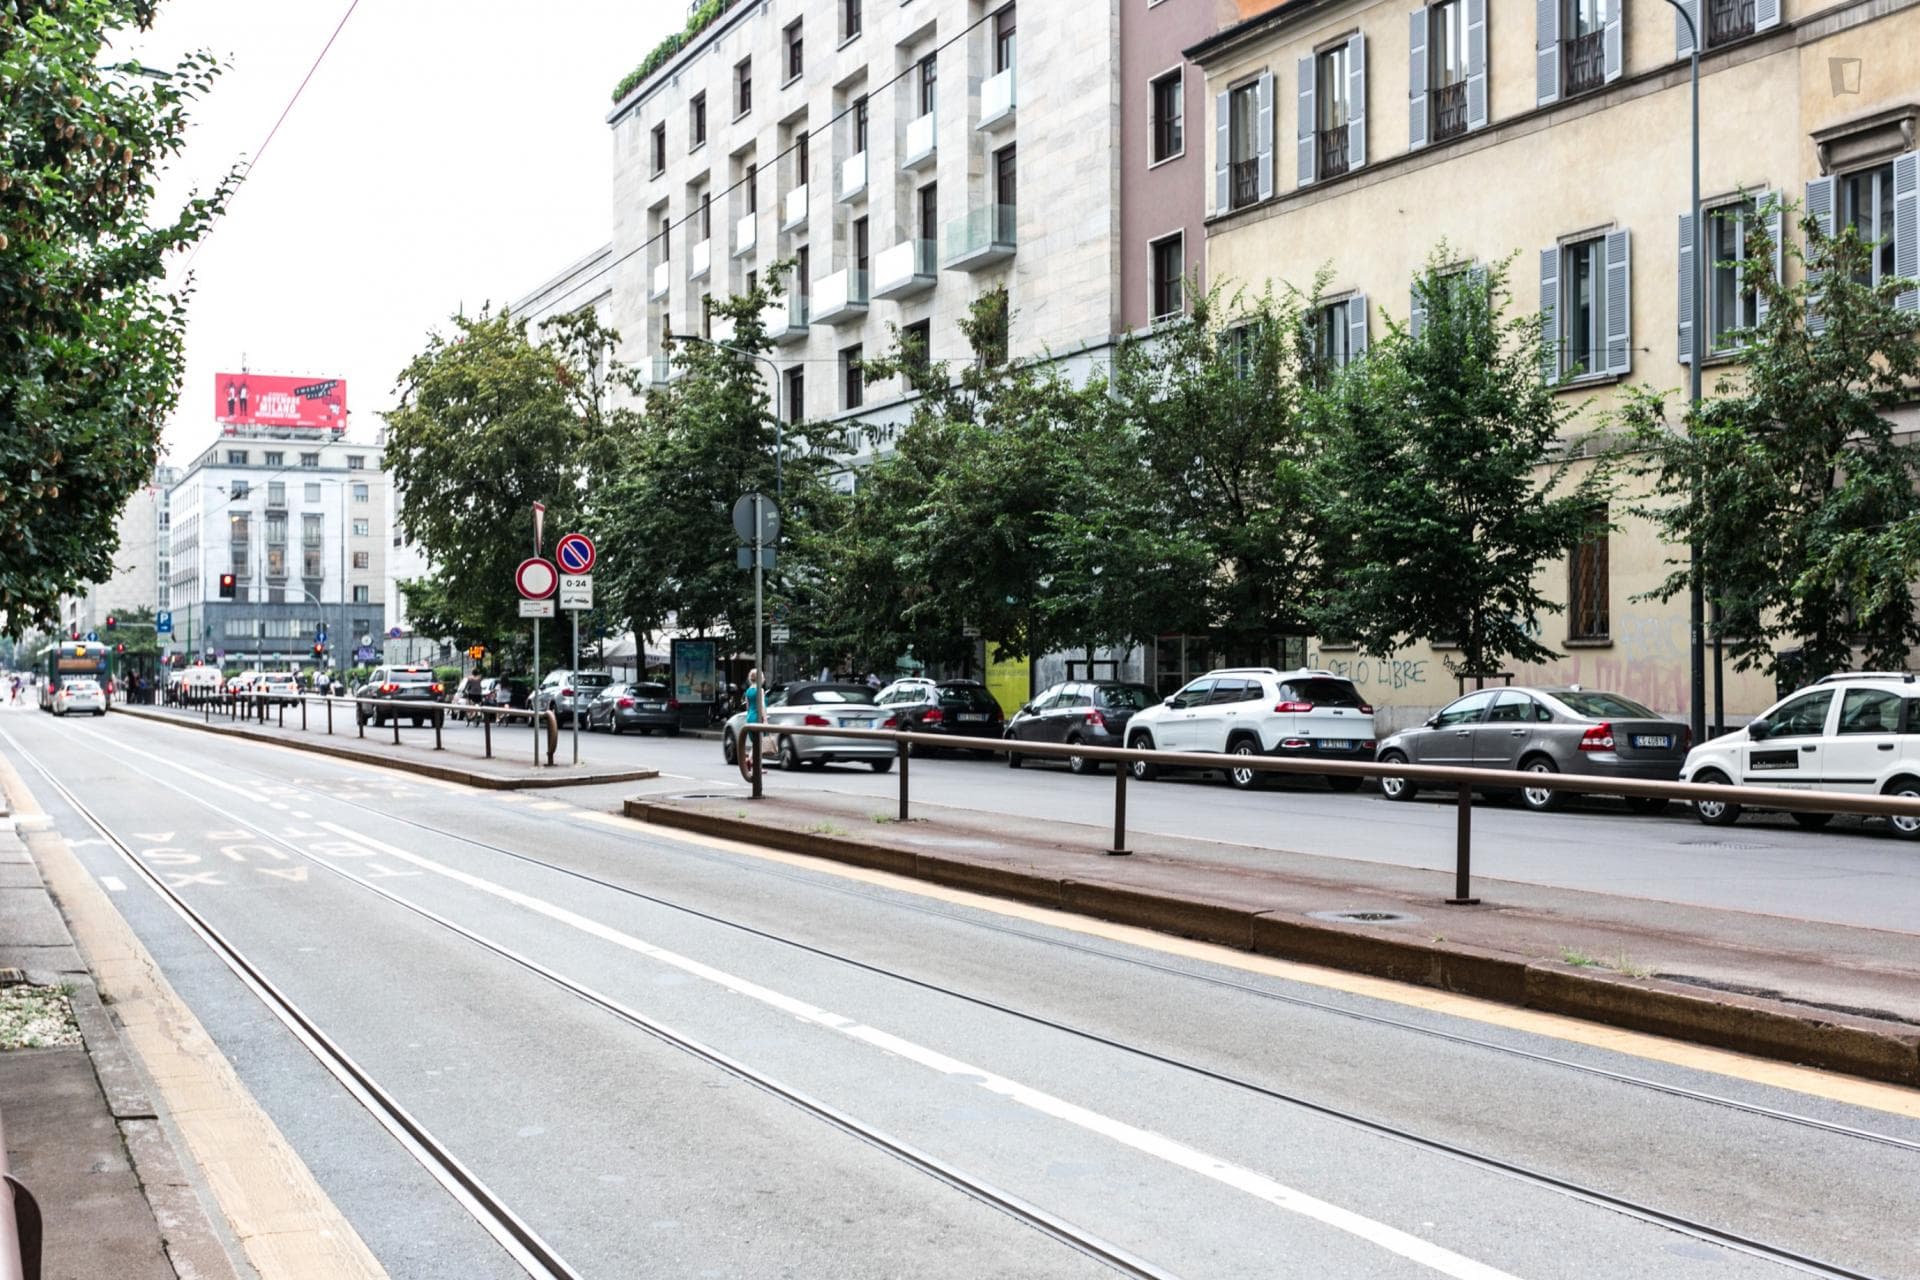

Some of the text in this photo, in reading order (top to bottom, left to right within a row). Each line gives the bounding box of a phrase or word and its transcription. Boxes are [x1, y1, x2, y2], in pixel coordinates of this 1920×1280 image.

[260, 402, 296, 413] MILANO
[566, 580, 587, 588] 0-24
[160, 613, 169, 624] P
[1378, 660, 1429, 689] LIBRE
